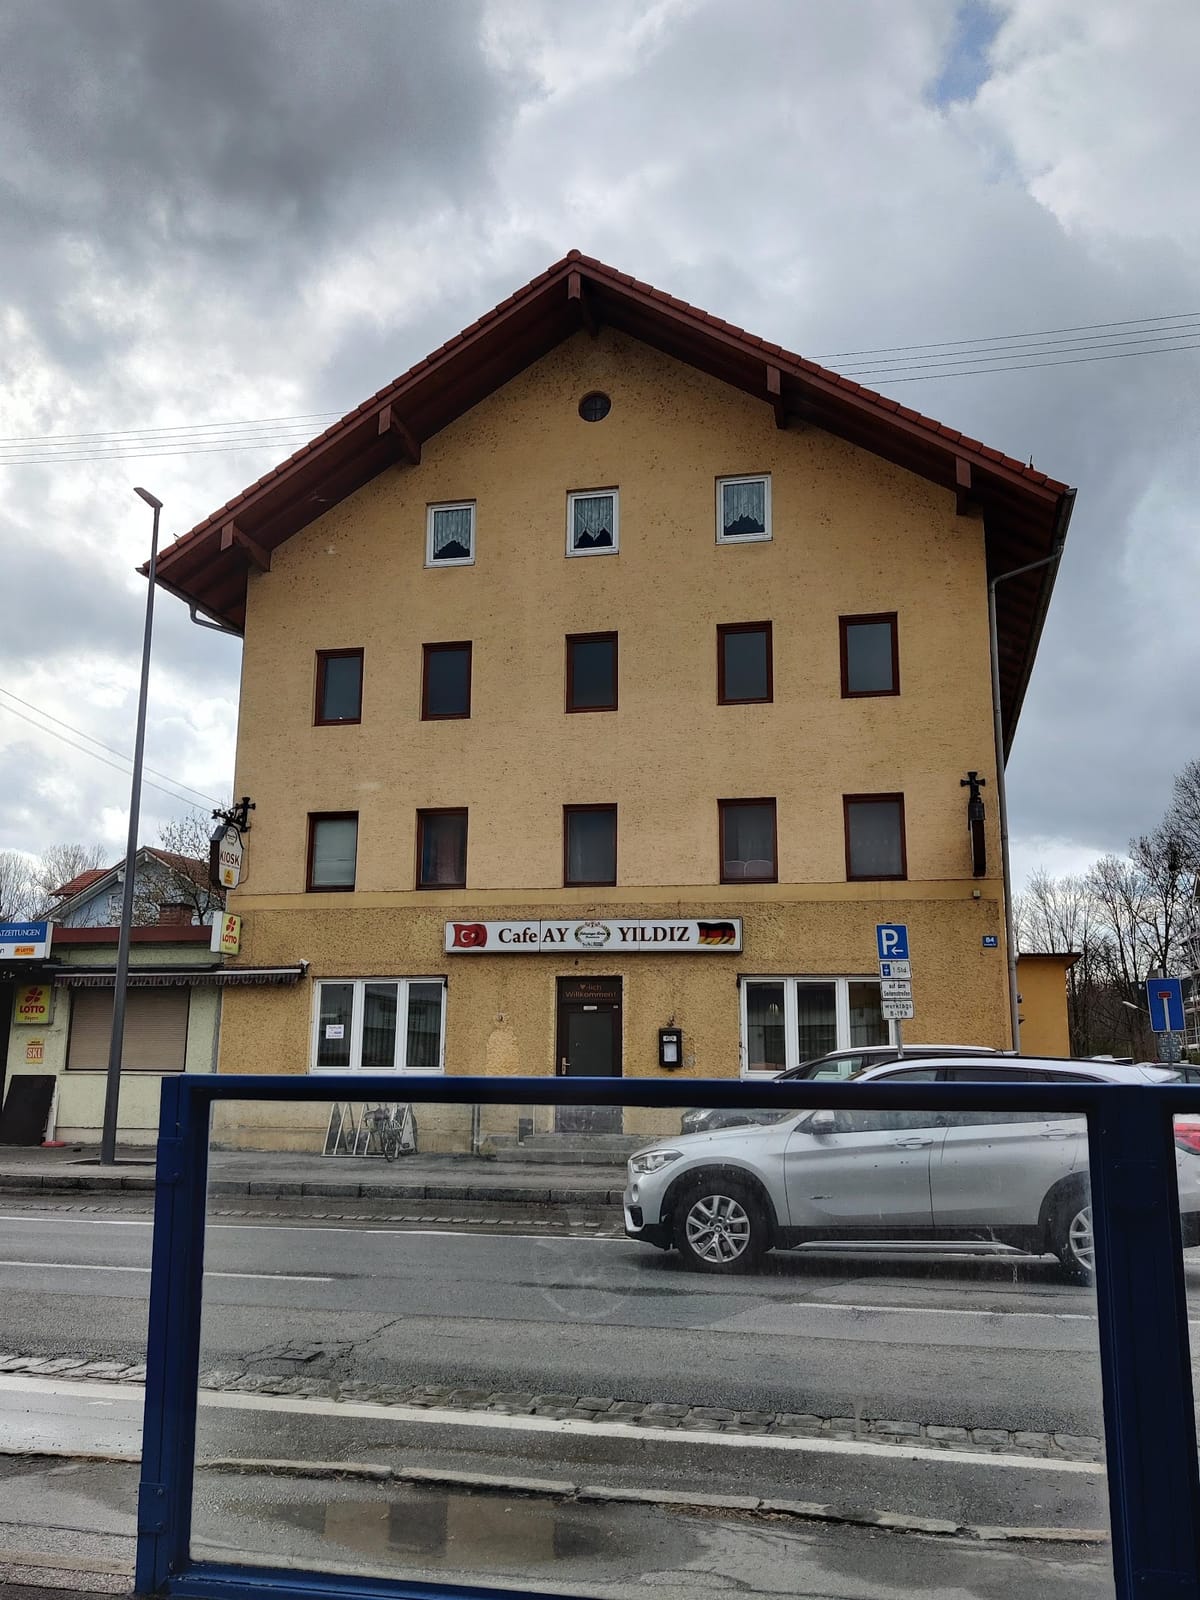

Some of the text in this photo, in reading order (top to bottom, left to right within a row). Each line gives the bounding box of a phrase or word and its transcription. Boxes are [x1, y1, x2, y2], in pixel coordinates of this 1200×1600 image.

[220, 850, 240, 866] KIOSK
[222, 934, 238, 944] LOTTO
[498, 927, 538, 944] Cafe
[542, 927, 569, 943] AY
[618, 926, 690, 942] YILDIZ
[881, 929, 898, 955] P
[20, 1005, 45, 1014] LOTTO
